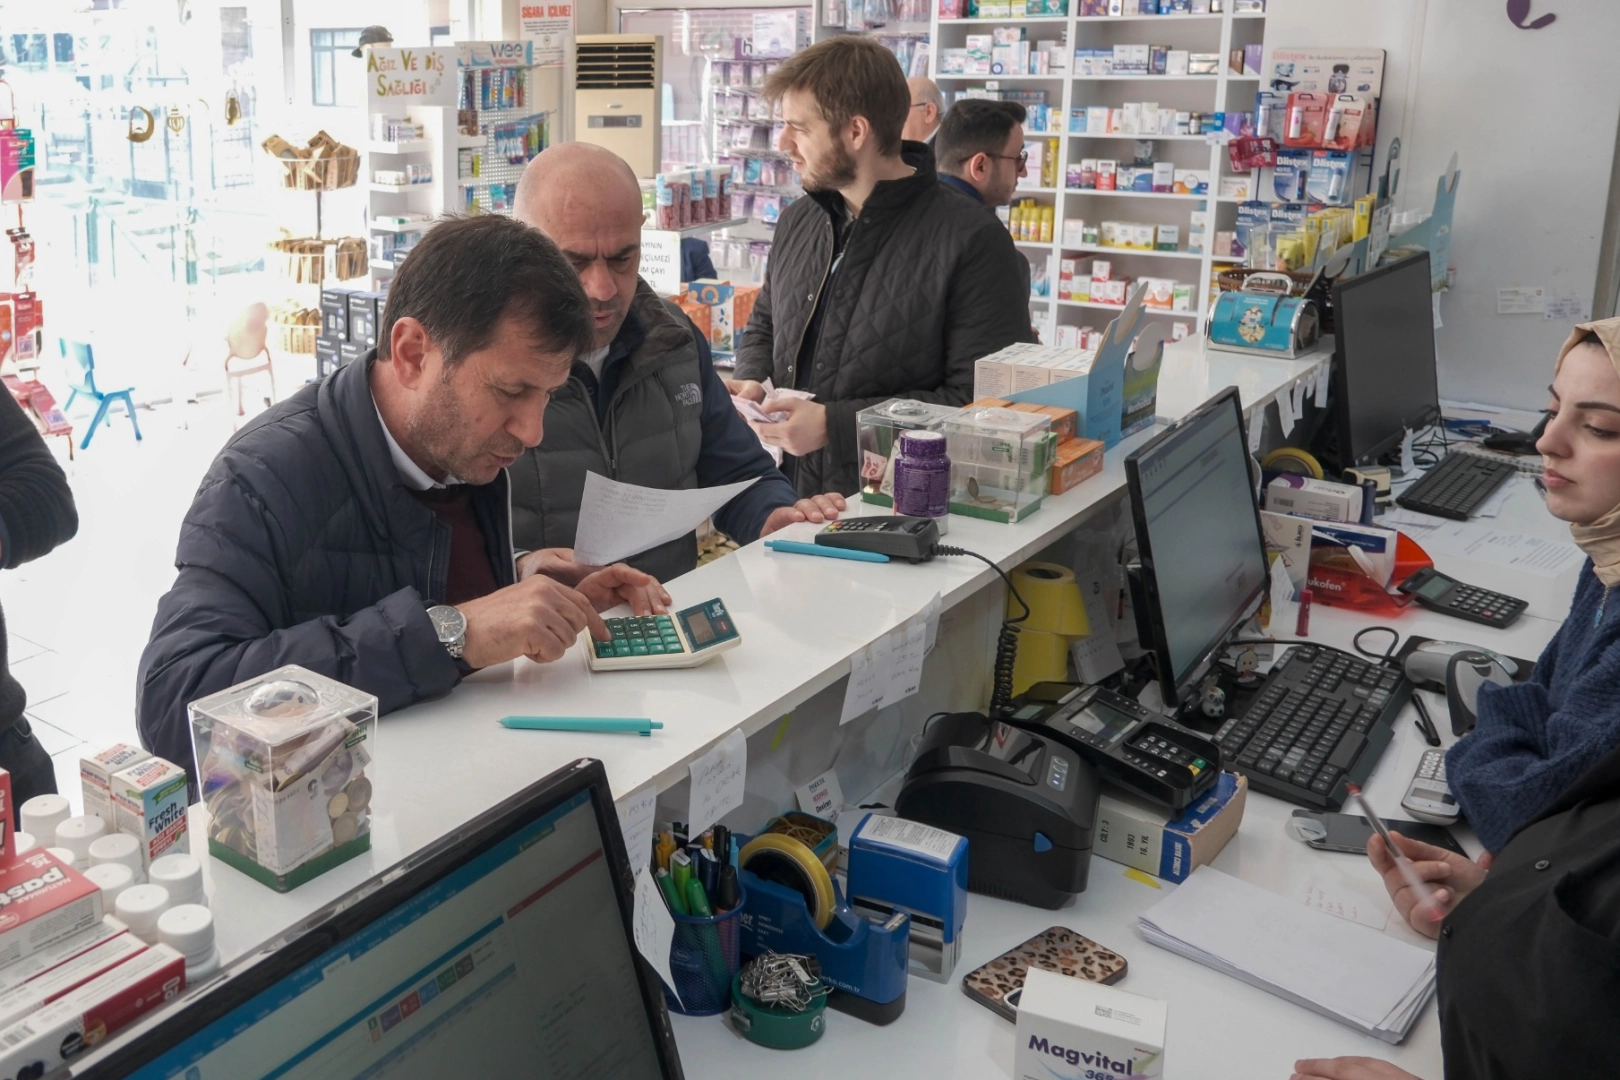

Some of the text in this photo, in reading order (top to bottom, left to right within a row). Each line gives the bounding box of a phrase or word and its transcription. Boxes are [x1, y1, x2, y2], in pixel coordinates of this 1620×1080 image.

[522, 4, 571, 19] SİGARA İÇİLMEZ
[490, 43, 523, 58] wee
[1276, 156, 1308, 168] Blistex
[1312, 158, 1346, 169] Blistex
[1238, 206, 1268, 217] Blistex
[1272, 209, 1304, 220] Blistex
[680, 383, 691, 392] THE
[682, 398, 695, 407] FACE
[1307, 578, 1342, 591] ukofen
[148, 802, 177, 829] Fresh
[154, 806, 185, 834] White
[1126, 834, 1136, 850] 1993
[1028, 1034, 1133, 1076] Magvital
